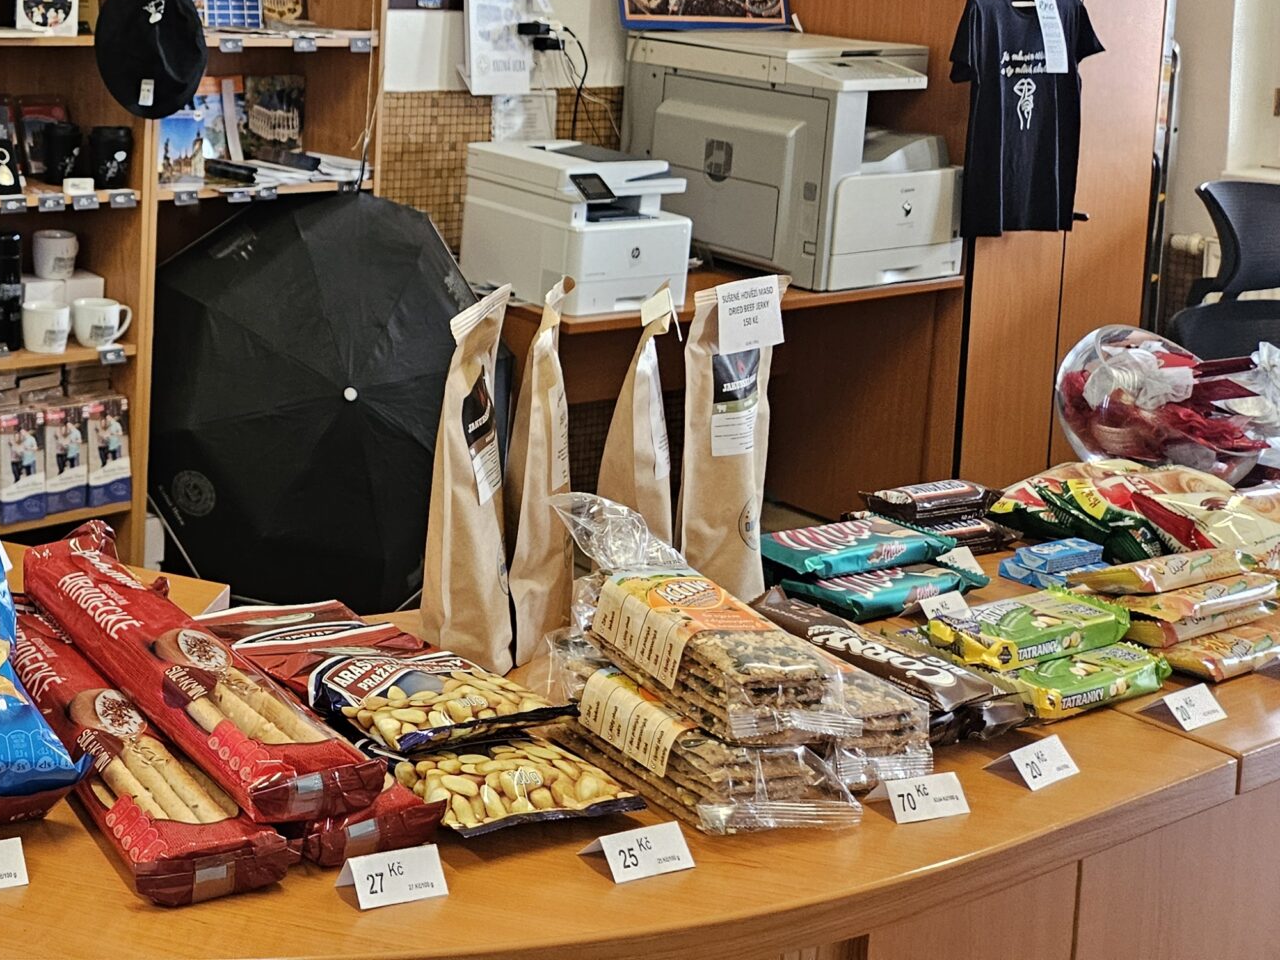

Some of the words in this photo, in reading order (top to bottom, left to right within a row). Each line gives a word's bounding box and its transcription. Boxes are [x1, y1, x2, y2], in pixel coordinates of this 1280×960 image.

[759, 287, 773, 297] MASO
[729, 306, 744, 316] DRIED
[744, 303, 755, 313] BEEF
[756, 301, 770, 310] JERKY
[743, 317, 752, 326] 150
[58, 572, 145, 640] HRADECKÉ
[1018, 639, 1062, 660] TATRANKY
[1061, 688, 1104, 710] TATRANKY
[1176, 705, 1191, 722] 20
[1026, 761, 1042, 779] 20
[897, 793, 916, 812] 70
[915, 784, 929, 798] Kč
[618, 847, 639, 870] 25
[636, 837, 652, 852] Kč
[366, 872, 384, 895] 27
[388, 862, 404, 876] Kč
